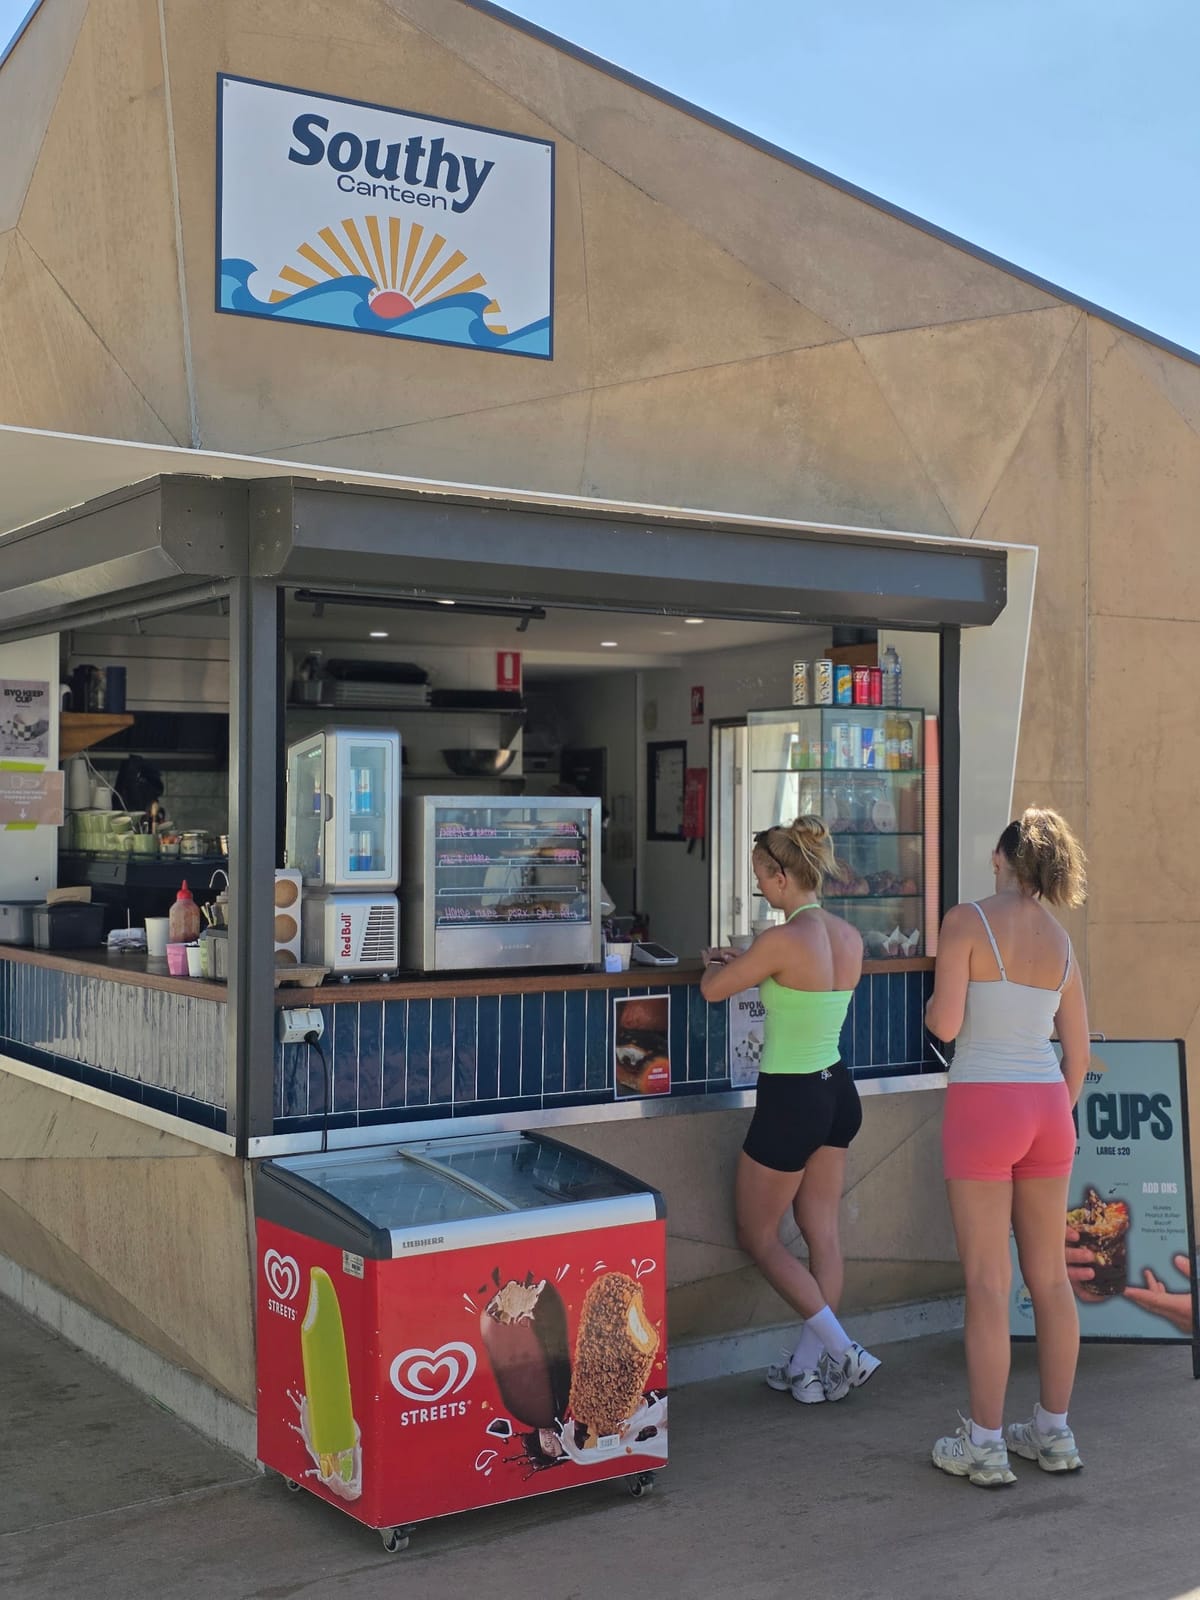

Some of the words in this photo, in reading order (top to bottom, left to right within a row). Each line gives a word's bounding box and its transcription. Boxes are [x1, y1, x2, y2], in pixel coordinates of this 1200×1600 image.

[288, 113, 495, 214] Southy
[337, 174, 447, 211] Canteen
[4, 689, 21, 697] BYO
[739, 1001, 755, 1010] BYO
[1087, 1093, 1173, 1140] CUPS
[1096, 1146, 1116, 1156] LARGE
[1117, 1146, 1131, 1156] $20
[1142, 1182, 1159, 1194] ADD
[1161, 1182, 1178, 1194] ONS
[402, 1236, 445, 1249] LIEBHERR
[268, 1298, 296, 1321] STREETS
[401, 1401, 466, 1427] STREETS
